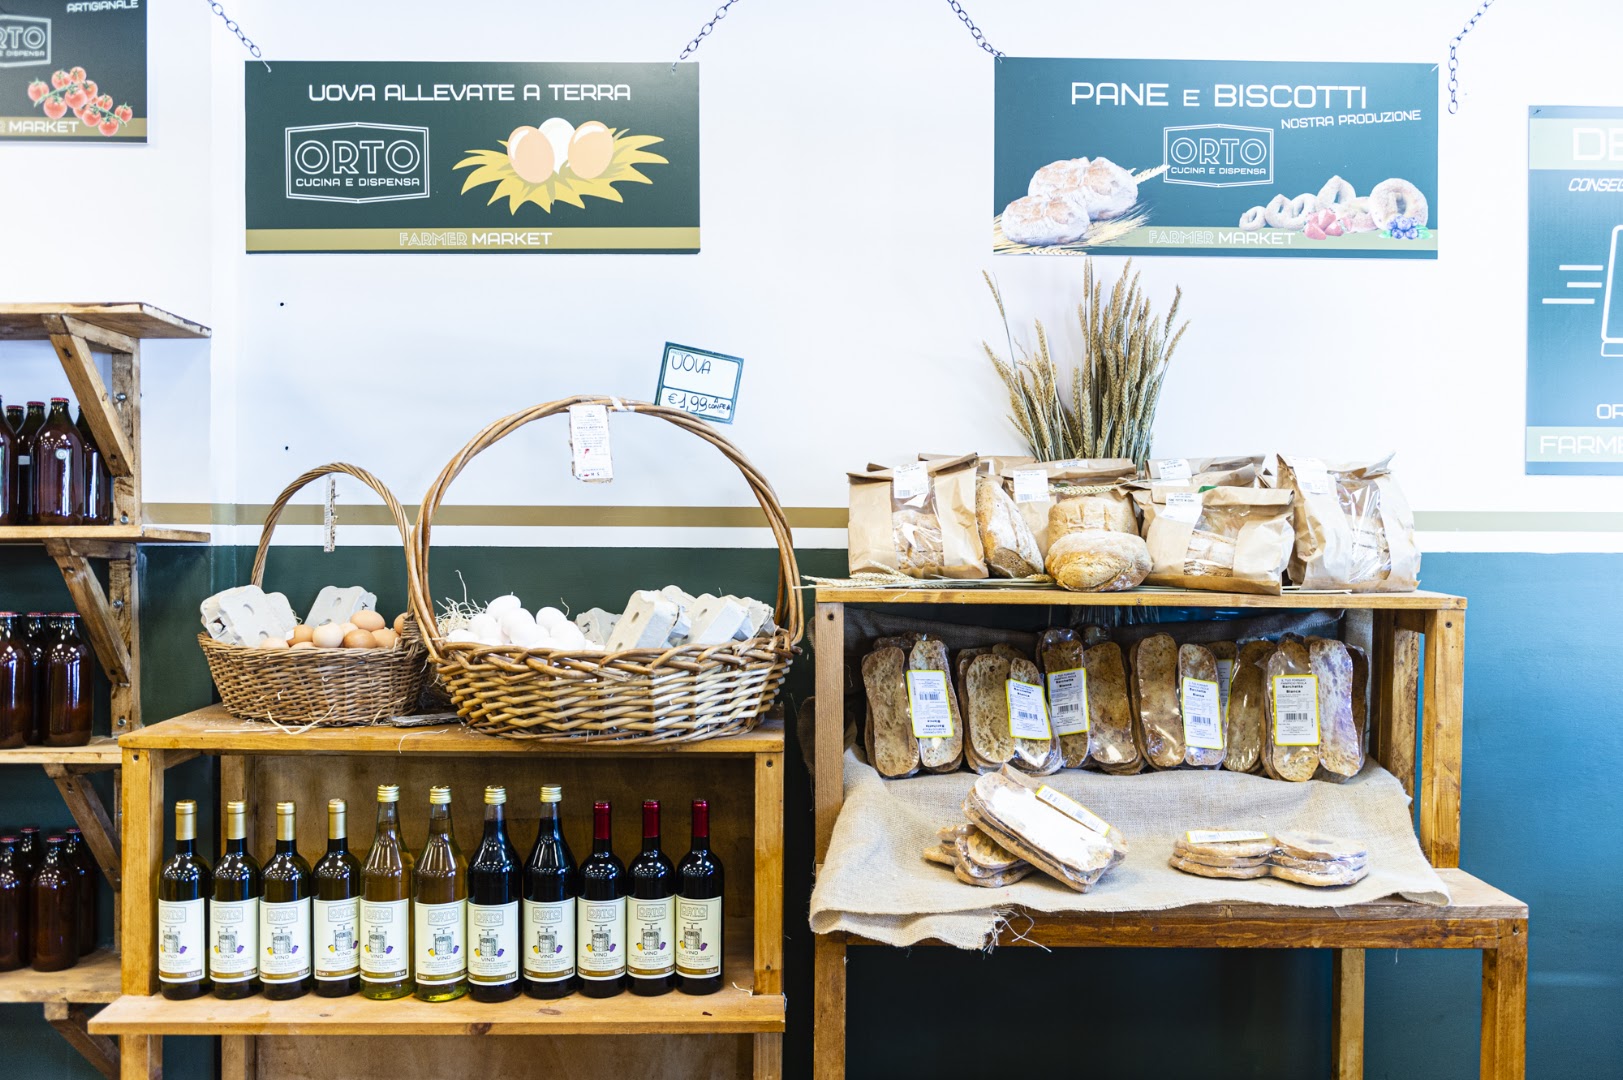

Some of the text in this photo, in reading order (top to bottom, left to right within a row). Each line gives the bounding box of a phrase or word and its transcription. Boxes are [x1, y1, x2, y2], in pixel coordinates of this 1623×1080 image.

[66, 0, 140, 13] ARTIGIANALE
[308, 84, 631, 101] UOVA ALLEVATE A TERRA
[1070, 81, 1366, 109] PANE E BISCOTTI
[9, 120, 80, 133] MARKET
[1281, 110, 1422, 130] NOSTRA PRODUZIONE
[295, 140, 420, 175] ORTO
[1170, 138, 1267, 166] ORTO
[1170, 166, 1266, 176] CUCINA E DISPENSA
[296, 178, 420, 188] CUCINA E DISPENSA
[399, 232, 553, 246] FARMER MARKET
[1148, 230, 1296, 246] FARMER MARKET
[672, 354, 712, 374] UOVA
[1596, 404, 1623, 420] OR
[268, 910, 296, 920] ORTO
[365, 908, 390, 918] ORTO
[430, 910, 457, 921] ORTO
[535, 910, 560, 918] ORTO
[589, 908, 614, 917] ORTO
[639, 907, 665, 916] ORTO
[682, 906, 706, 916] ORTO
